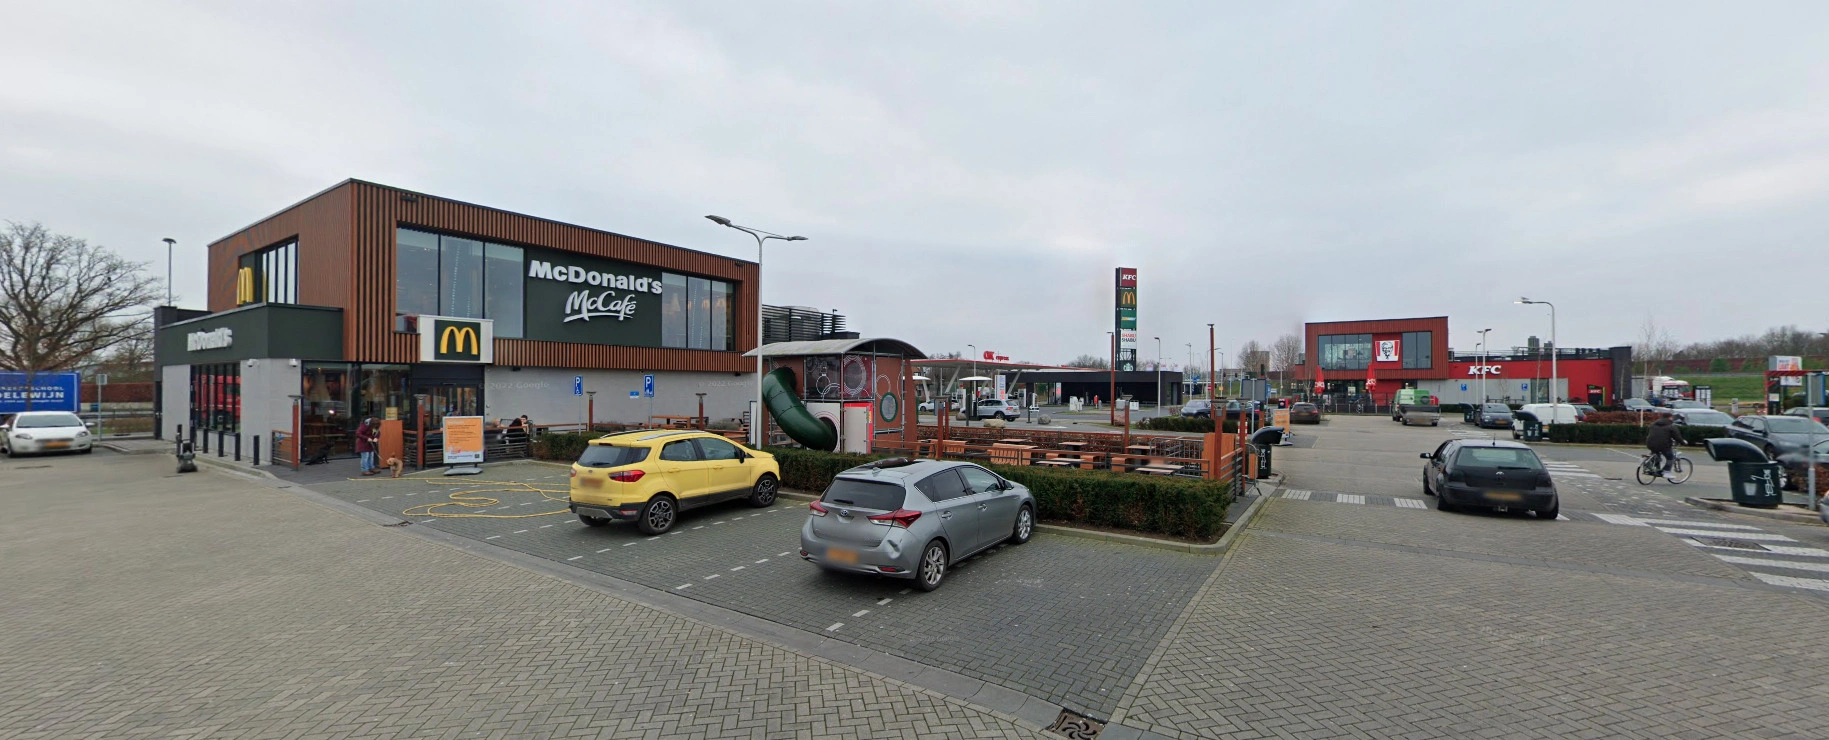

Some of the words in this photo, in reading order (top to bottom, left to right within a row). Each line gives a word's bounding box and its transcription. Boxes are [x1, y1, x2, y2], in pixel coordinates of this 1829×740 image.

[528, 260, 662, 294] McDonald's
[564, 289, 637, 321] McCafé
[1467, 365, 1502, 376] KFC
